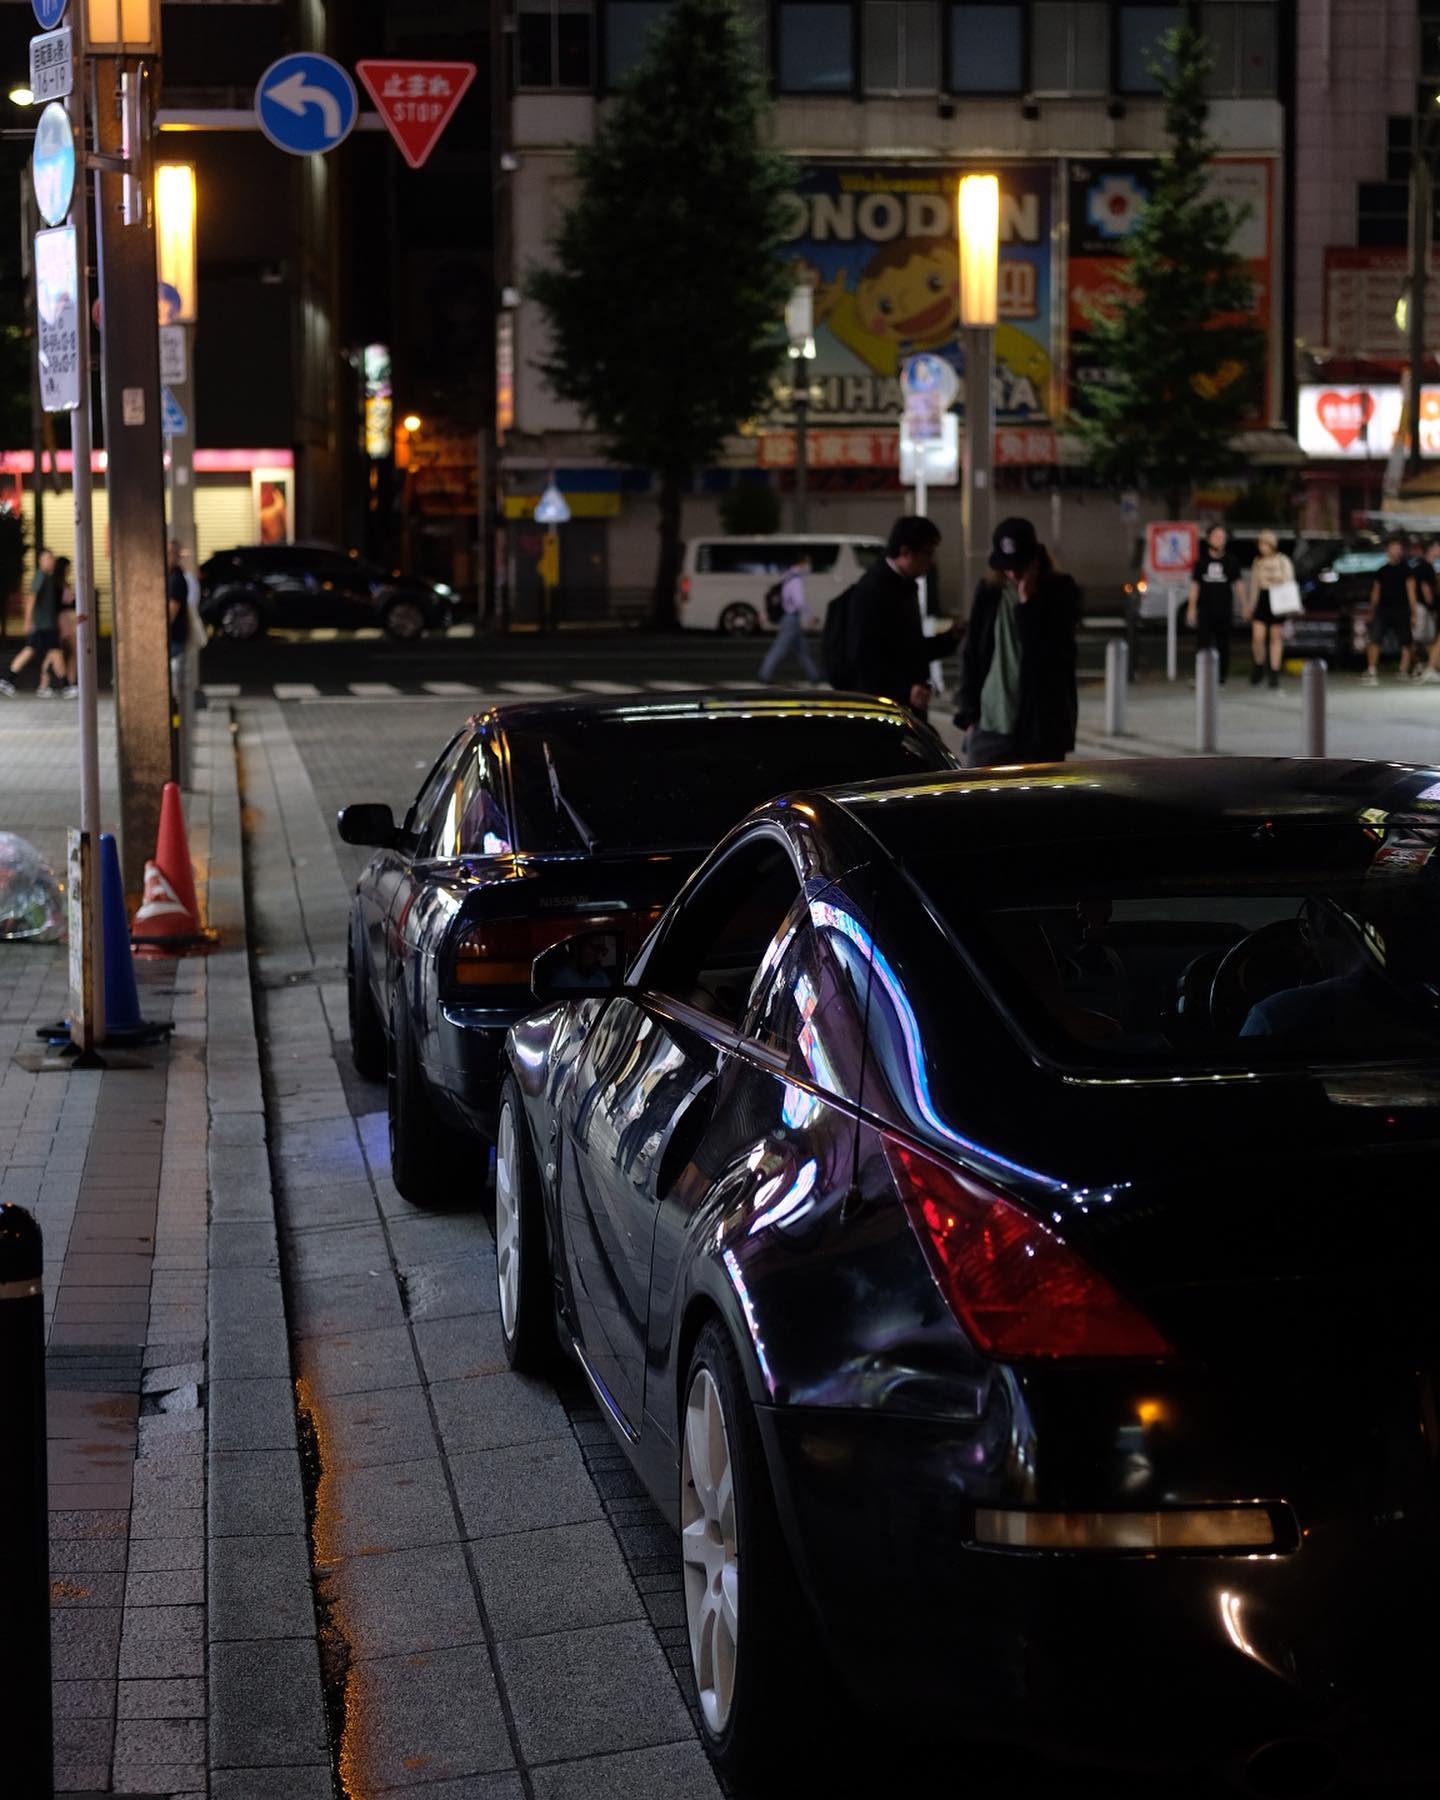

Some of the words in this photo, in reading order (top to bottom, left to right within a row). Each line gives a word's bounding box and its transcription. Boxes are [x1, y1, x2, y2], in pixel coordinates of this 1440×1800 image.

[381, 73, 453, 97] 止まれ
[394, 102, 443, 122] STOP
[770, 192, 1040, 241] ONODN
[538, 896, 590, 909] NISSAN
